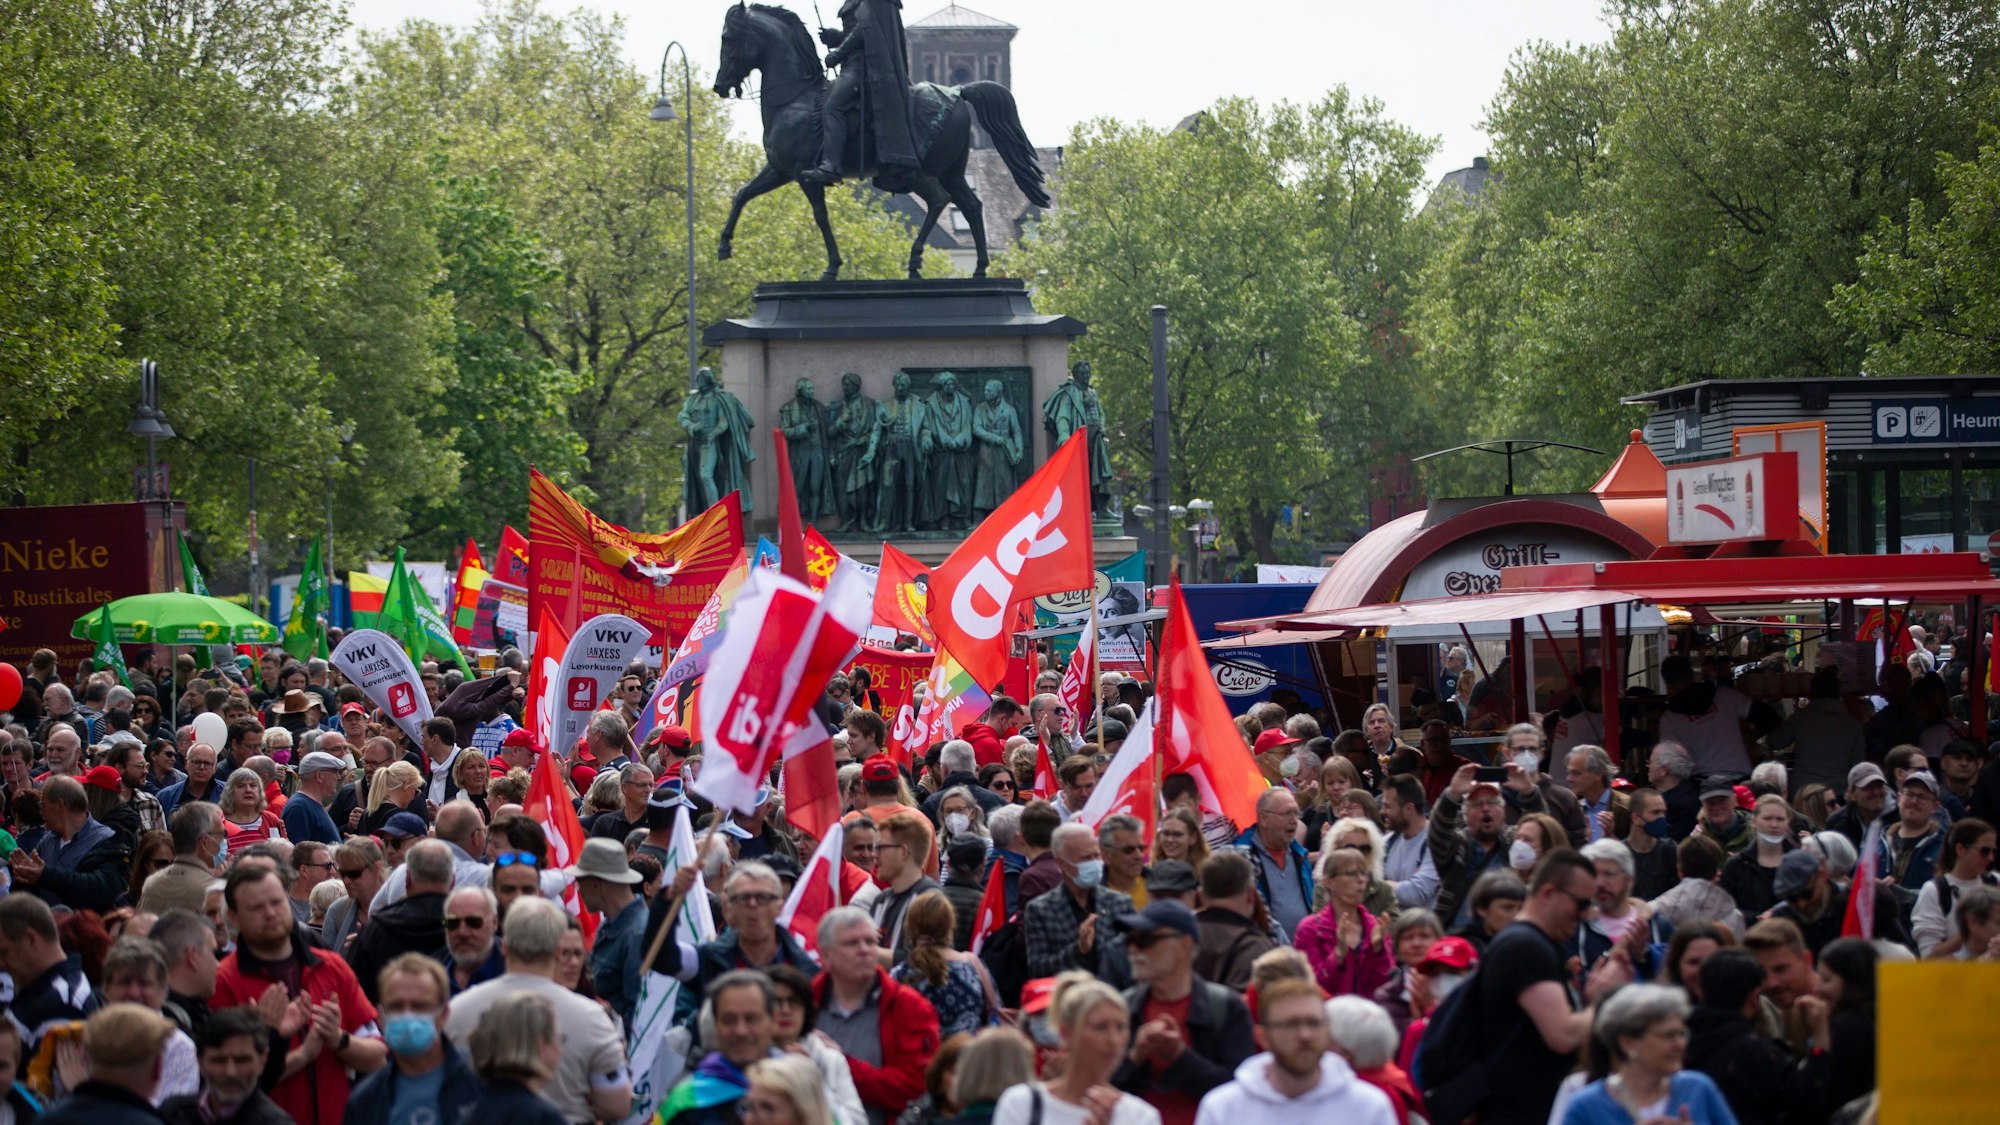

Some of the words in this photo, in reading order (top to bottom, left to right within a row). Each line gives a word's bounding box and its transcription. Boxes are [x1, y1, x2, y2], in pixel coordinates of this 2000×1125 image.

[1, 538, 110, 573] Nieke
[1482, 543, 1560, 570] Grill-
[13, 586, 113, 607] Rustikales
[537, 584, 553, 594] FÜR
[594, 629, 633, 643] VKV
[345, 643, 376, 664] VKV
[586, 647, 621, 659] LANXESS
[361, 658, 391, 675] LANXESS
[571, 662, 623, 672] Leverkusen
[362, 668, 407, 688] Leverkusen
[1217, 665, 1261, 689] Crêpe
